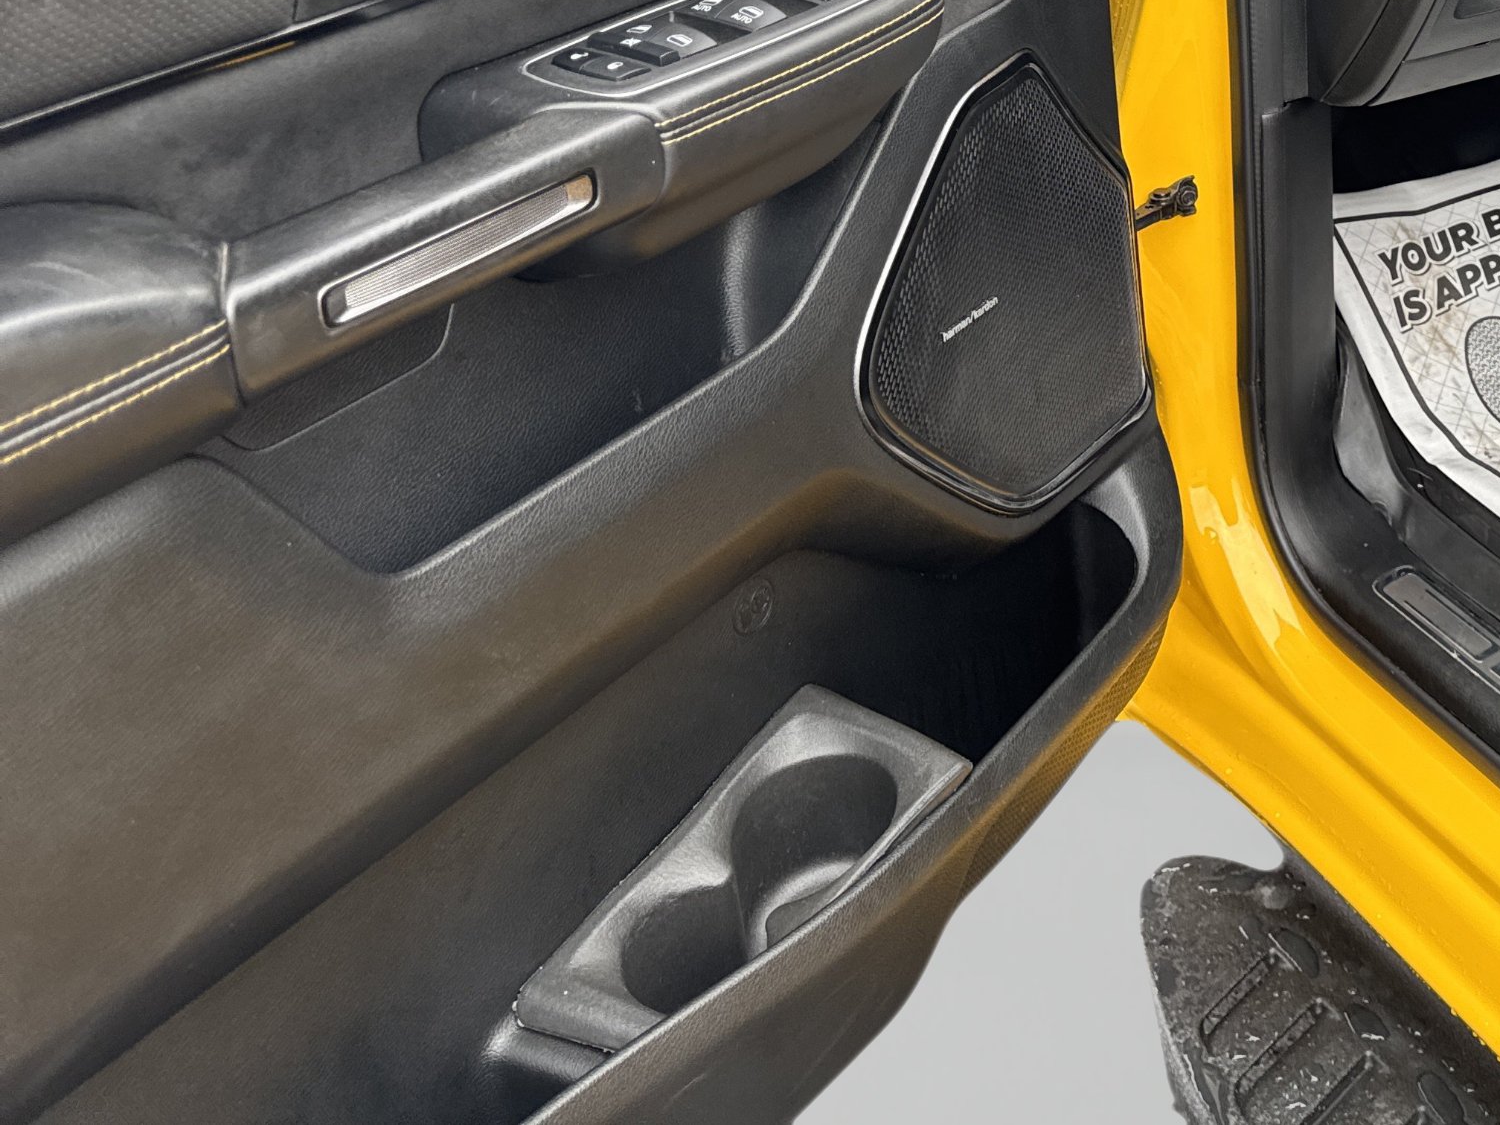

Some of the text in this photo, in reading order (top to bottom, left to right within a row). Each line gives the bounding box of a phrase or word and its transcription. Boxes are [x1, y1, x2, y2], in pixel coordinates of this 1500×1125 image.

[691, 4, 712, 12] AUTO
[730, 12, 753, 24] AUTO
[1378, 222, 1480, 284] YOUR
[940, 296, 999, 343] harman/kardon
[1393, 288, 1431, 332] IS
